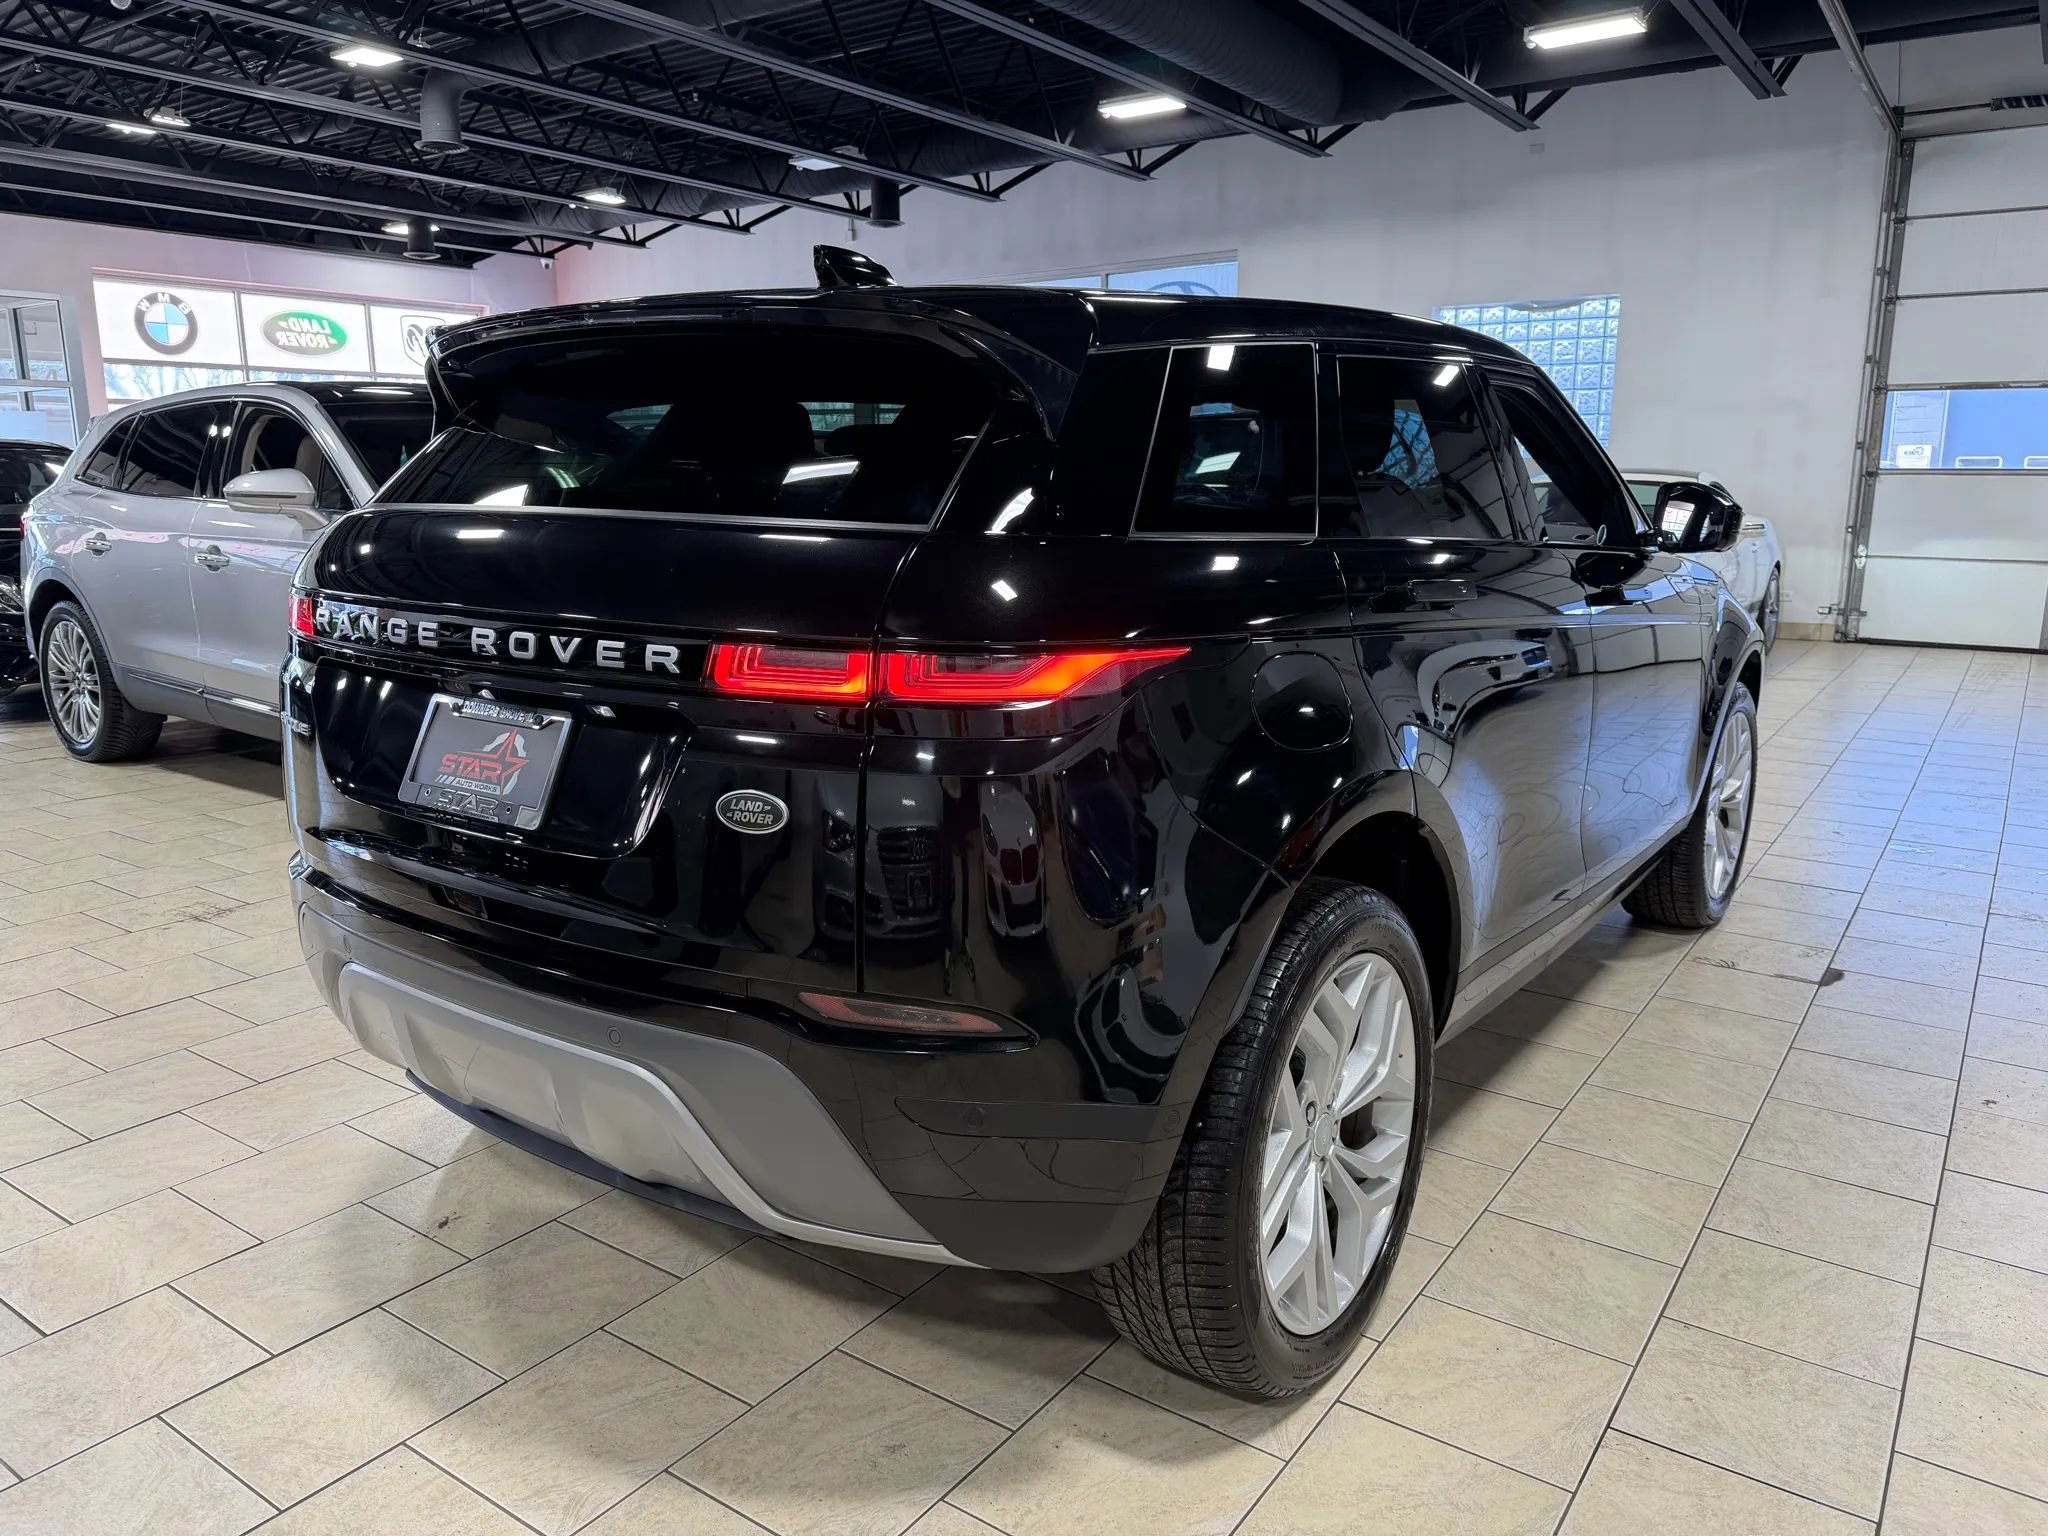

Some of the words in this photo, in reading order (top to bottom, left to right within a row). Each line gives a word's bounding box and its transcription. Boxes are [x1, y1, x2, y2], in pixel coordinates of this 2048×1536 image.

[314, 607, 440, 648] RANGE
[471, 628, 681, 674] ROVER
[437, 753, 502, 783] STAR
[455, 779, 472, 788] AUTO
[473, 783, 498, 793] WORKS
[438, 788, 499, 816] STAR
[730, 798, 764, 812] LAND
[733, 811, 774, 825] ROVER
